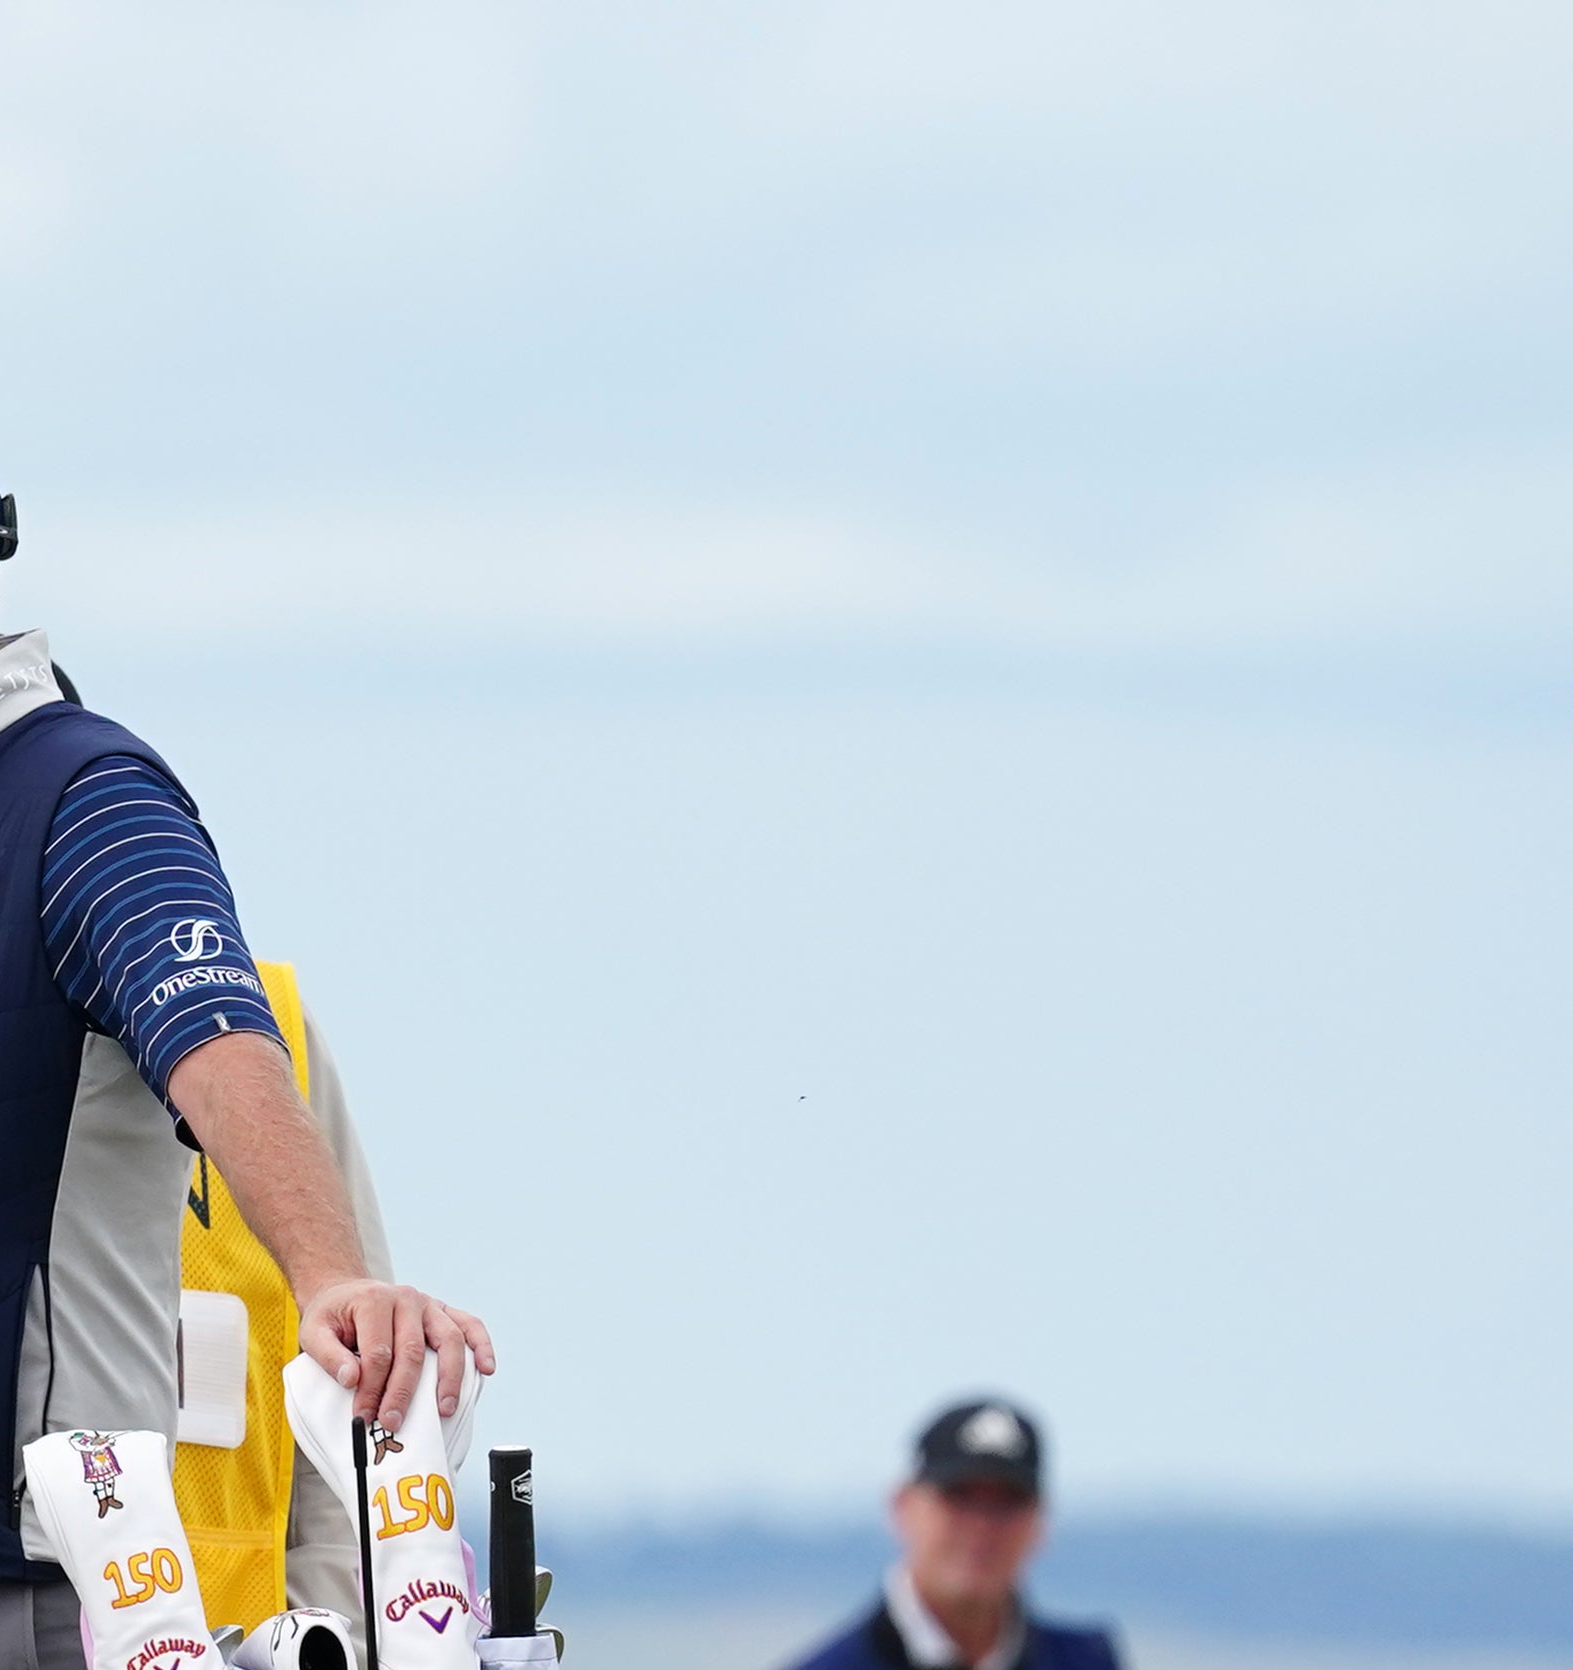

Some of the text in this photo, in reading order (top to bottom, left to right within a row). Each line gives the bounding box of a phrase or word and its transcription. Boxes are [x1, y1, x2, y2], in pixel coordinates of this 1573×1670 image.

[152, 967, 265, 1006] OneStream
[372, 1473, 455, 1541] 150
[103, 1547, 183, 1610] 150
[385, 1578, 470, 1623] Callaway
